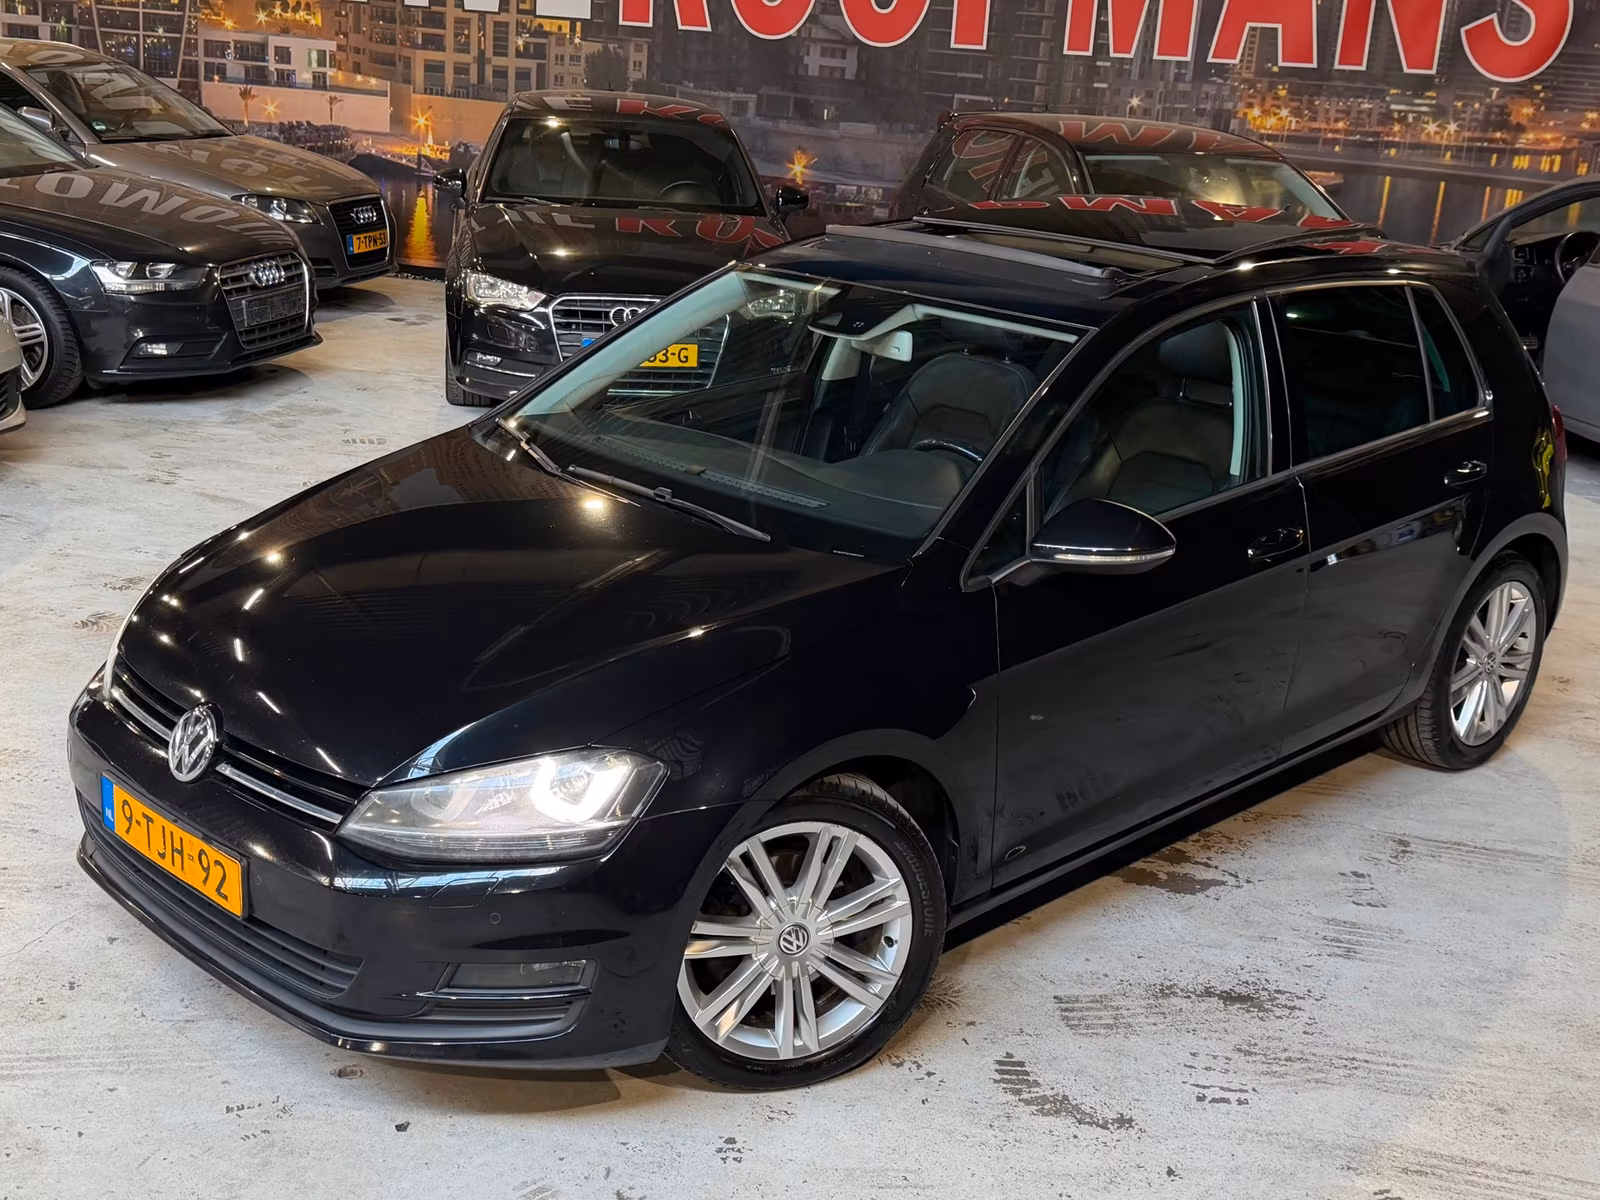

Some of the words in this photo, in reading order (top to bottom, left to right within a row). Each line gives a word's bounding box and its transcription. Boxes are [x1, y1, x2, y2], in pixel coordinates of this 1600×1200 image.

[619, 0, 1574, 83] MANS
[105, 806, 114, 822] NL
[121, 798, 230, 905] 9-TJH-92
